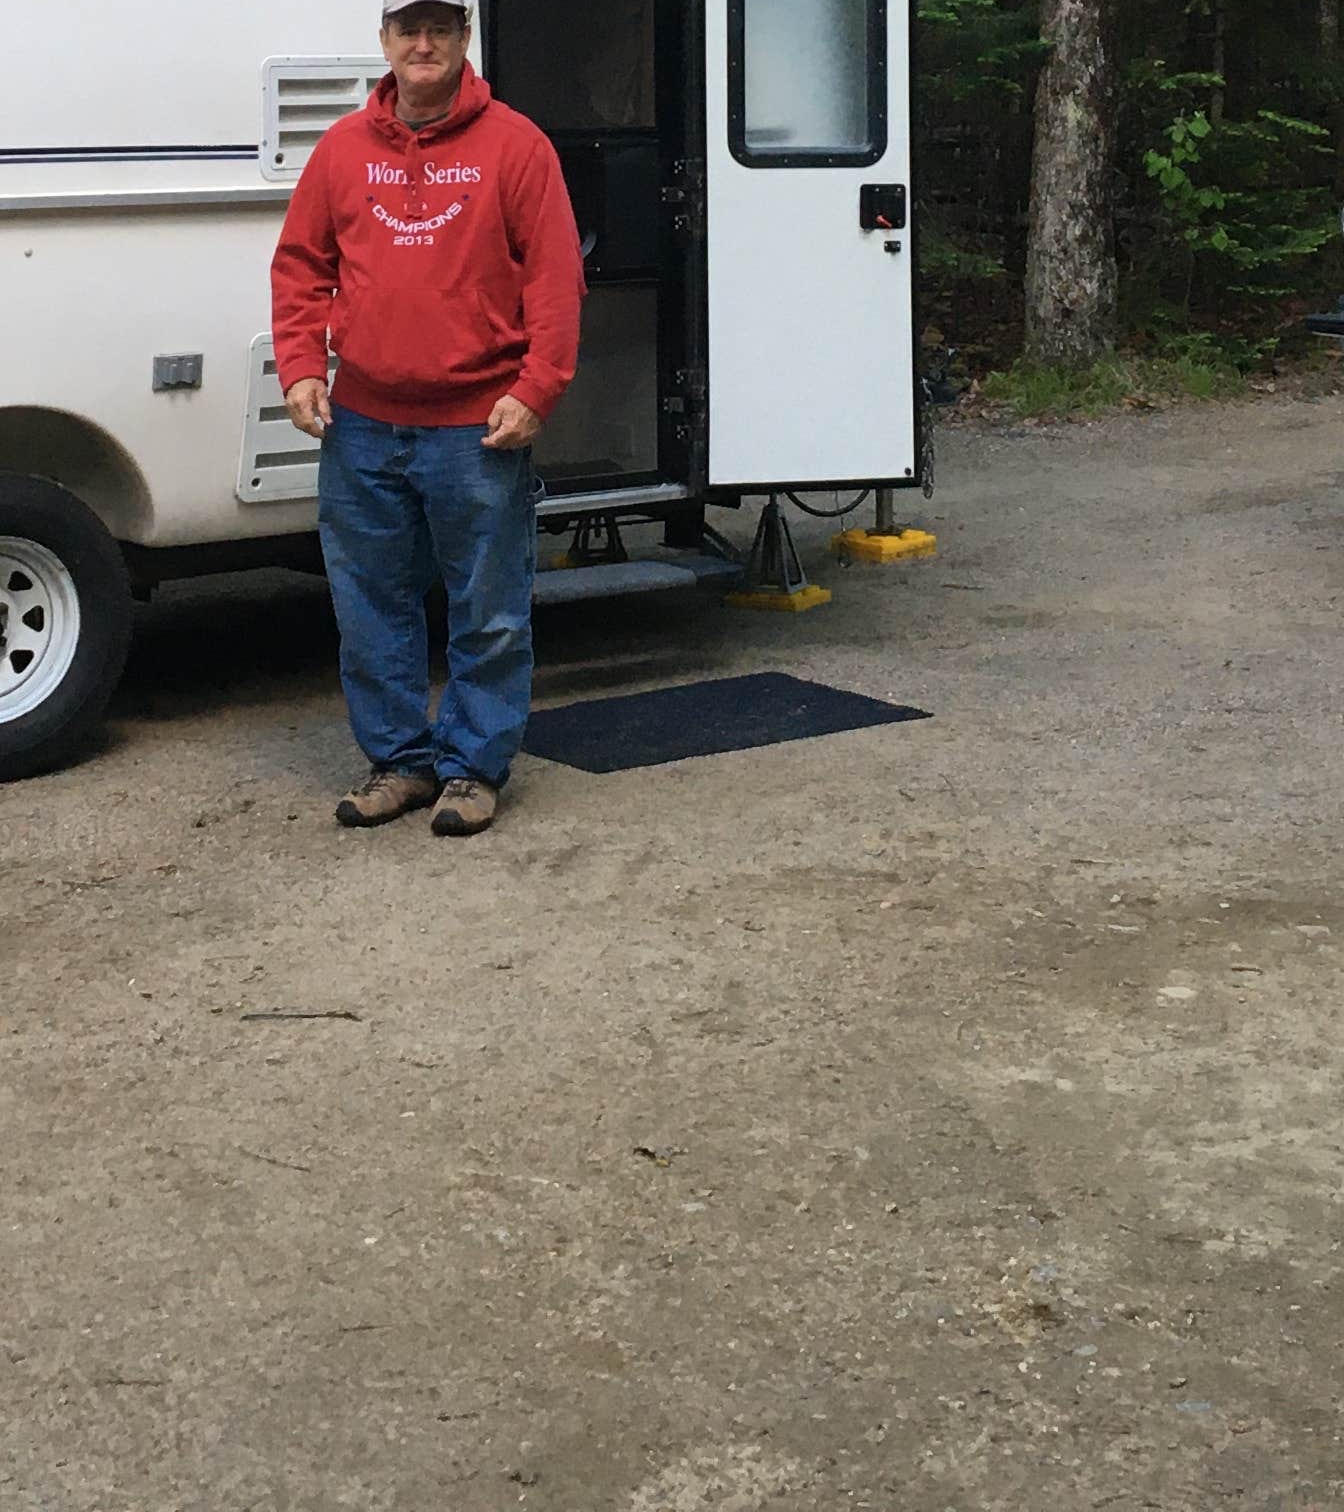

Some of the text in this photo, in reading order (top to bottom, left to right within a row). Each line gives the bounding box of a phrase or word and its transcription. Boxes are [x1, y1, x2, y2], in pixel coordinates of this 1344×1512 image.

[366, 161, 481, 185] Wor Series
[372, 202, 463, 233] CHAMPIONS
[393, 235, 434, 245] 2013
